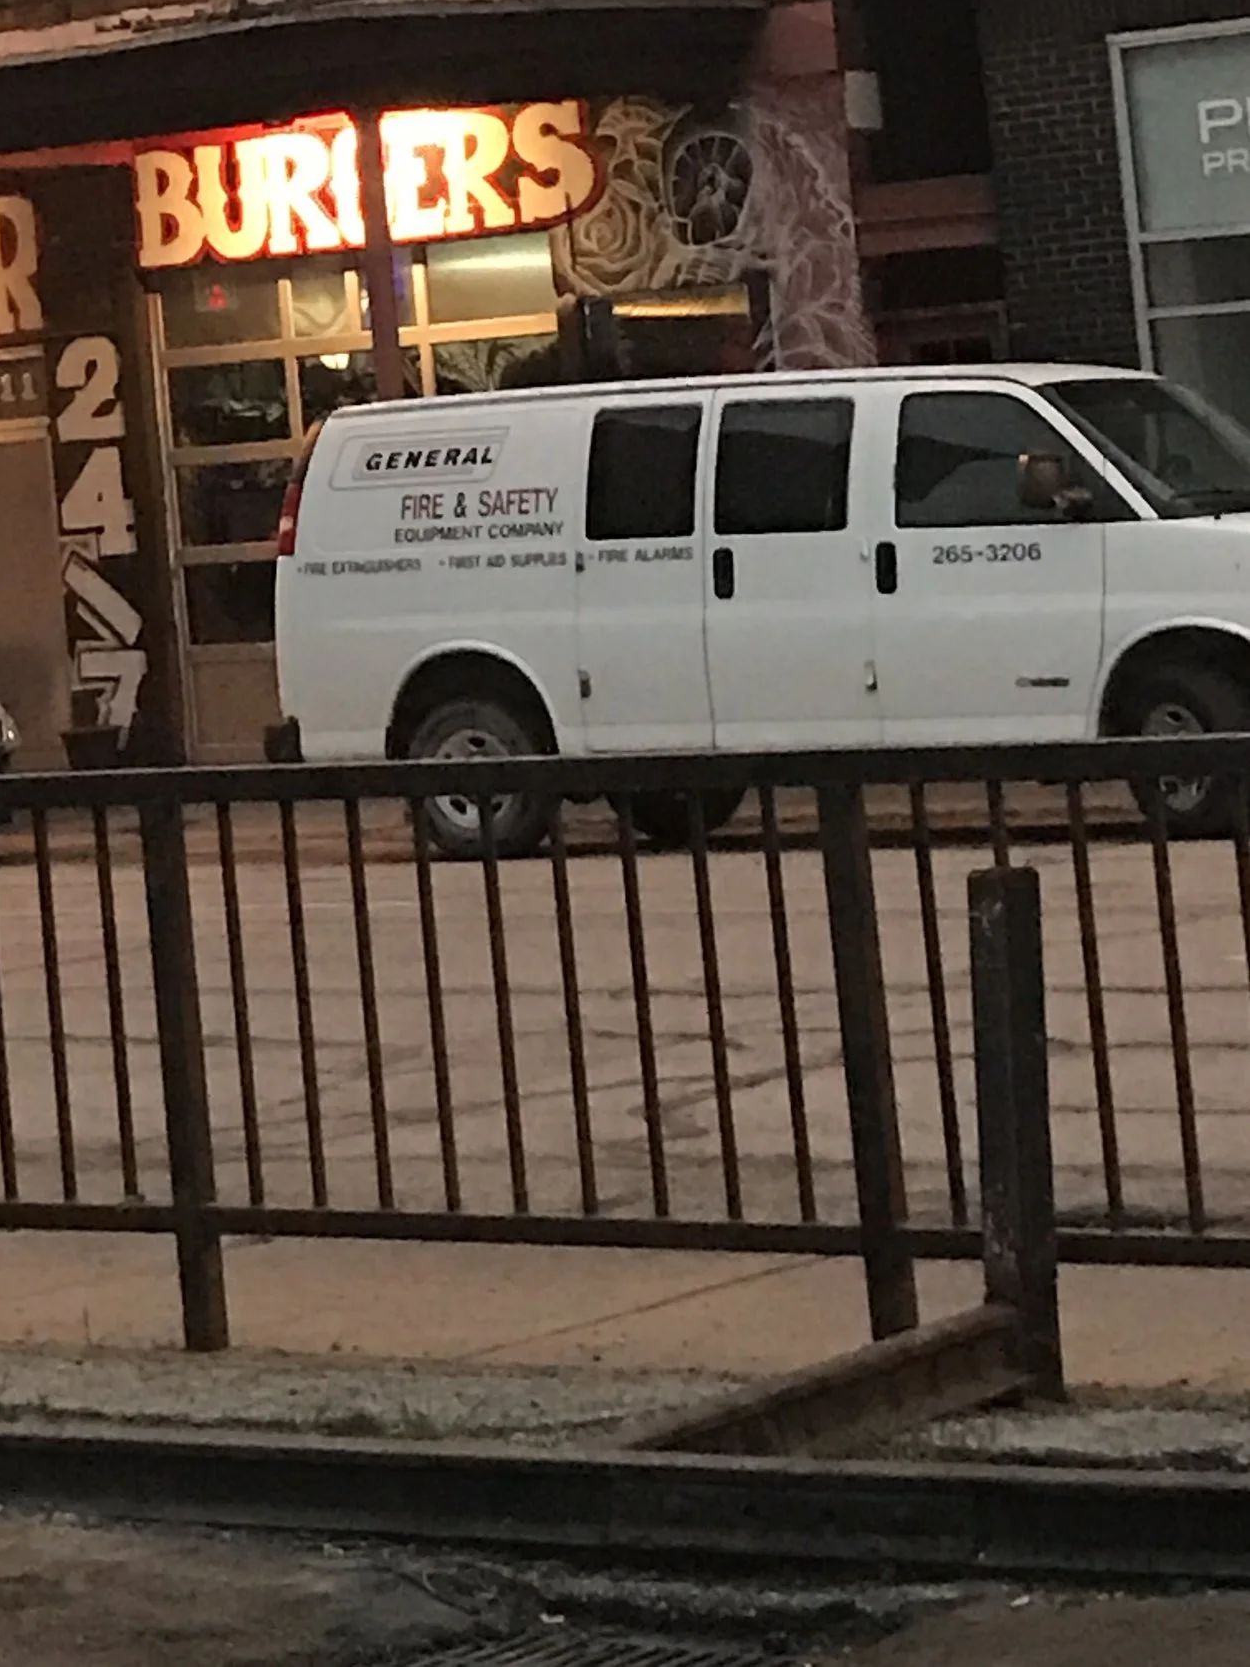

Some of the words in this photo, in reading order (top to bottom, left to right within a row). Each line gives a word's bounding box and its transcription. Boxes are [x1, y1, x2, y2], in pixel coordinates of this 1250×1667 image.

[1197, 96, 1250, 143] P
[364, 446, 494, 471] GENERAL
[400, 493, 444, 520] FIRE
[453, 492, 467, 519] &
[477, 487, 559, 518] SAFETY
[394, 524, 484, 544] EQUIPMENT
[488, 520, 565, 540] COMPANY
[598, 547, 628, 563] FIRE
[634, 545, 694, 562] ALARMS
[931, 541, 1042, 565] 265-3206
